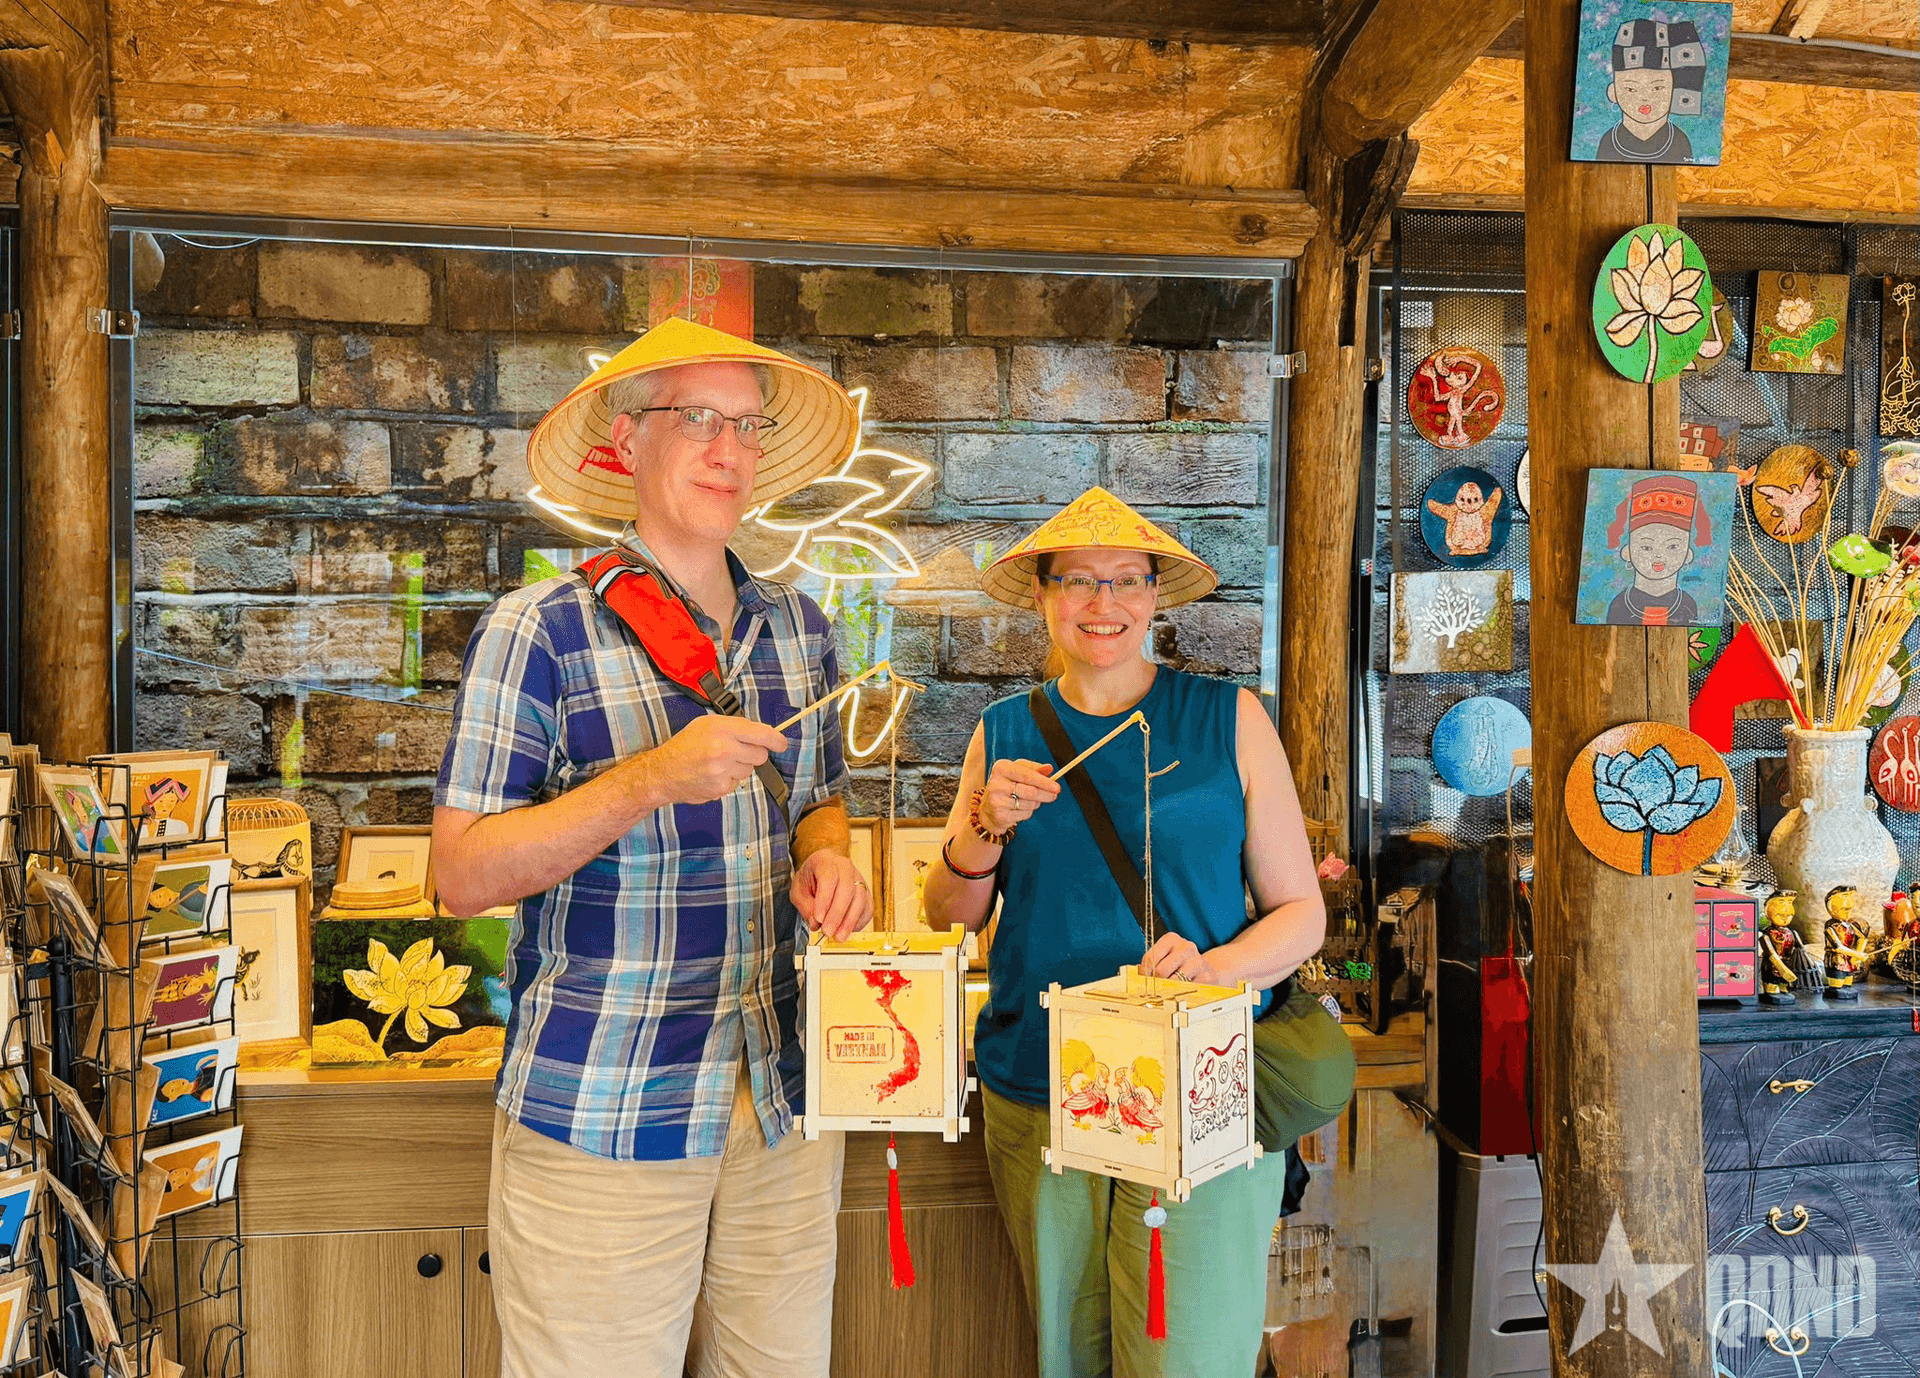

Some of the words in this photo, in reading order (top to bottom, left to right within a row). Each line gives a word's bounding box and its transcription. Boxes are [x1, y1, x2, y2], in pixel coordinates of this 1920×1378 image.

[844, 1032, 864, 1041] MADE
[866, 1032, 874, 1041] IN
[834, 1043, 886, 1057] VIETNAM
